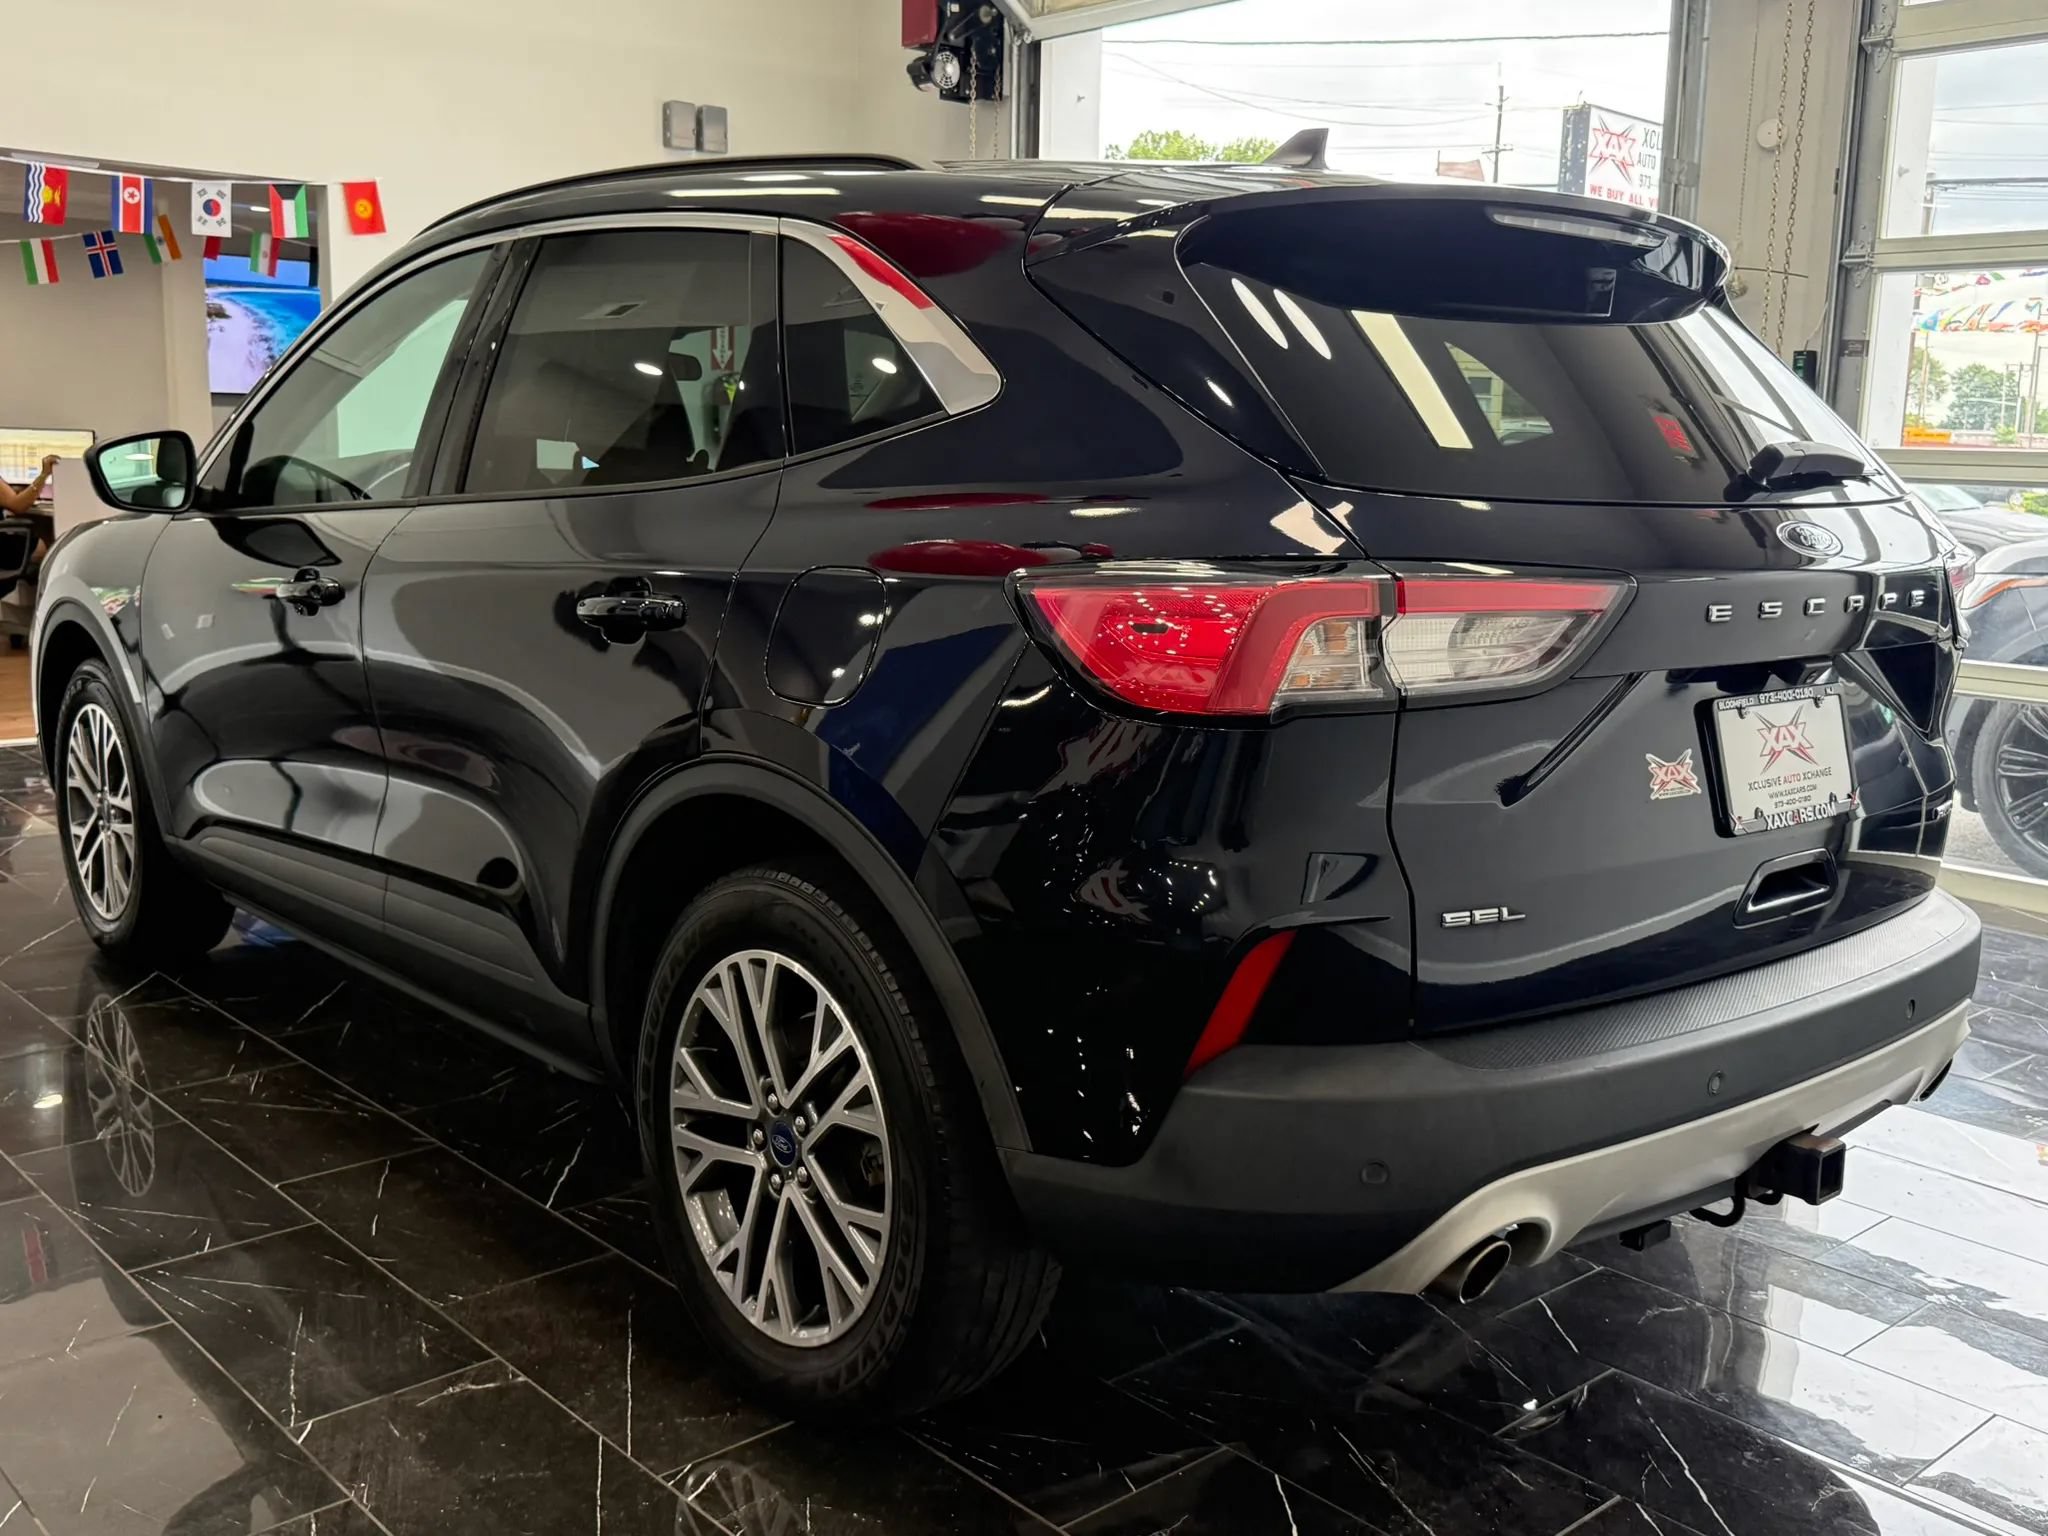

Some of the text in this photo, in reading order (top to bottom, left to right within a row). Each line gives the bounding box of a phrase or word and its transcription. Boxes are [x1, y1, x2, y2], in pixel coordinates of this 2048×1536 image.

[1636, 152, 1657, 170] AUTO
[1589, 184, 1603, 198] WE
[1606, 188, 1624, 202] BUY
[1629, 193, 1644, 207] ALL
[1706, 589, 1926, 623] ESCAPE
[1758, 687, 1814, 705] 973-400-0180
[1757, 722, 1814, 757] XAX
[1650, 762, 1697, 786] XAX
[1748, 766, 1832, 791] XCLUSIVE AUTO XCHANGE
[1765, 801, 1837, 830] XAXCARS.COM
[1442, 906, 1526, 929] SEL
